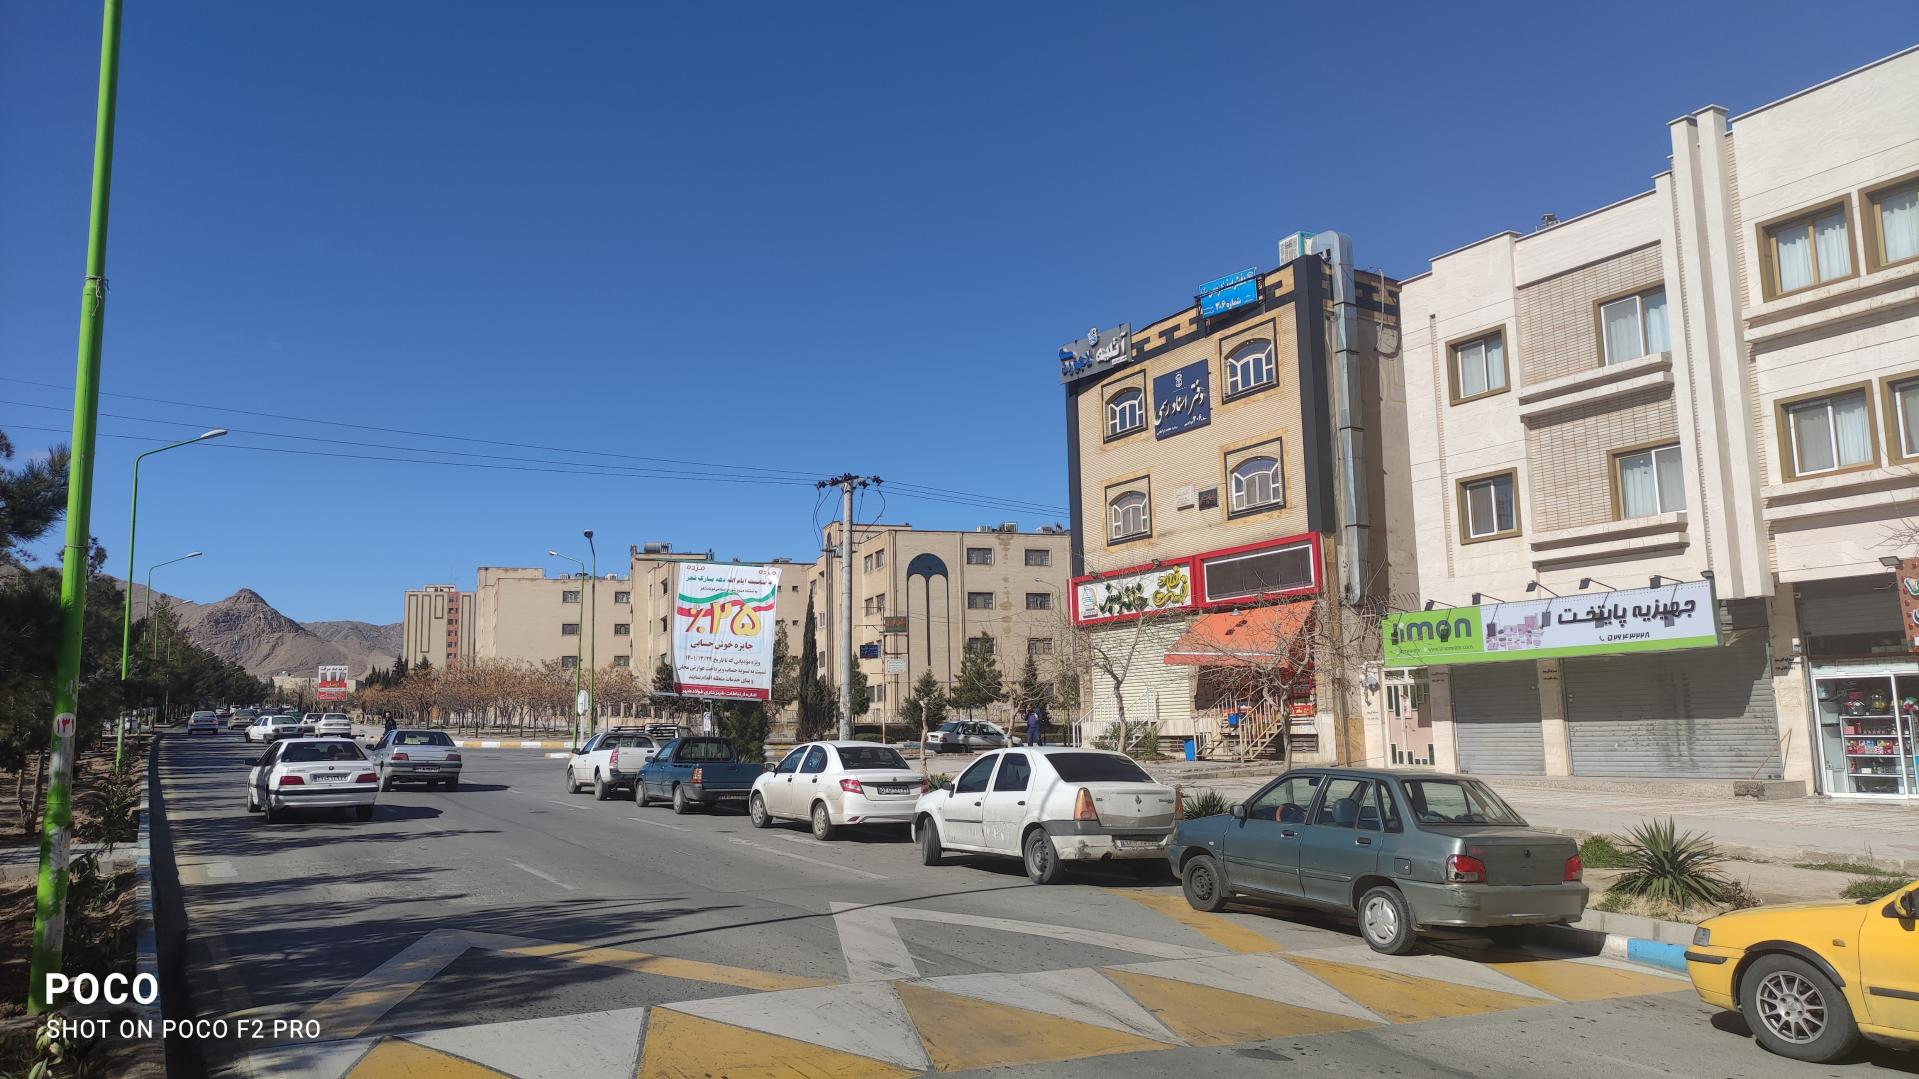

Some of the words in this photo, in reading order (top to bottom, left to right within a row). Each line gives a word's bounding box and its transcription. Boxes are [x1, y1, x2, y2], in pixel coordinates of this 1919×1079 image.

[1096, 332, 1128, 362] آتلیه
[1172, 394, 1188, 414] اسناد
[1188, 379, 1204, 416] دفتر
[686, 564, 705, 572] مژده
[1558, 603, 1627, 628] پایتخت
[1632, 599, 1697, 622] جهیزیه
[690, 638, 714, 649] حسابی
[715, 640, 733, 650] خوش
[734, 641, 753, 651] جایزه
